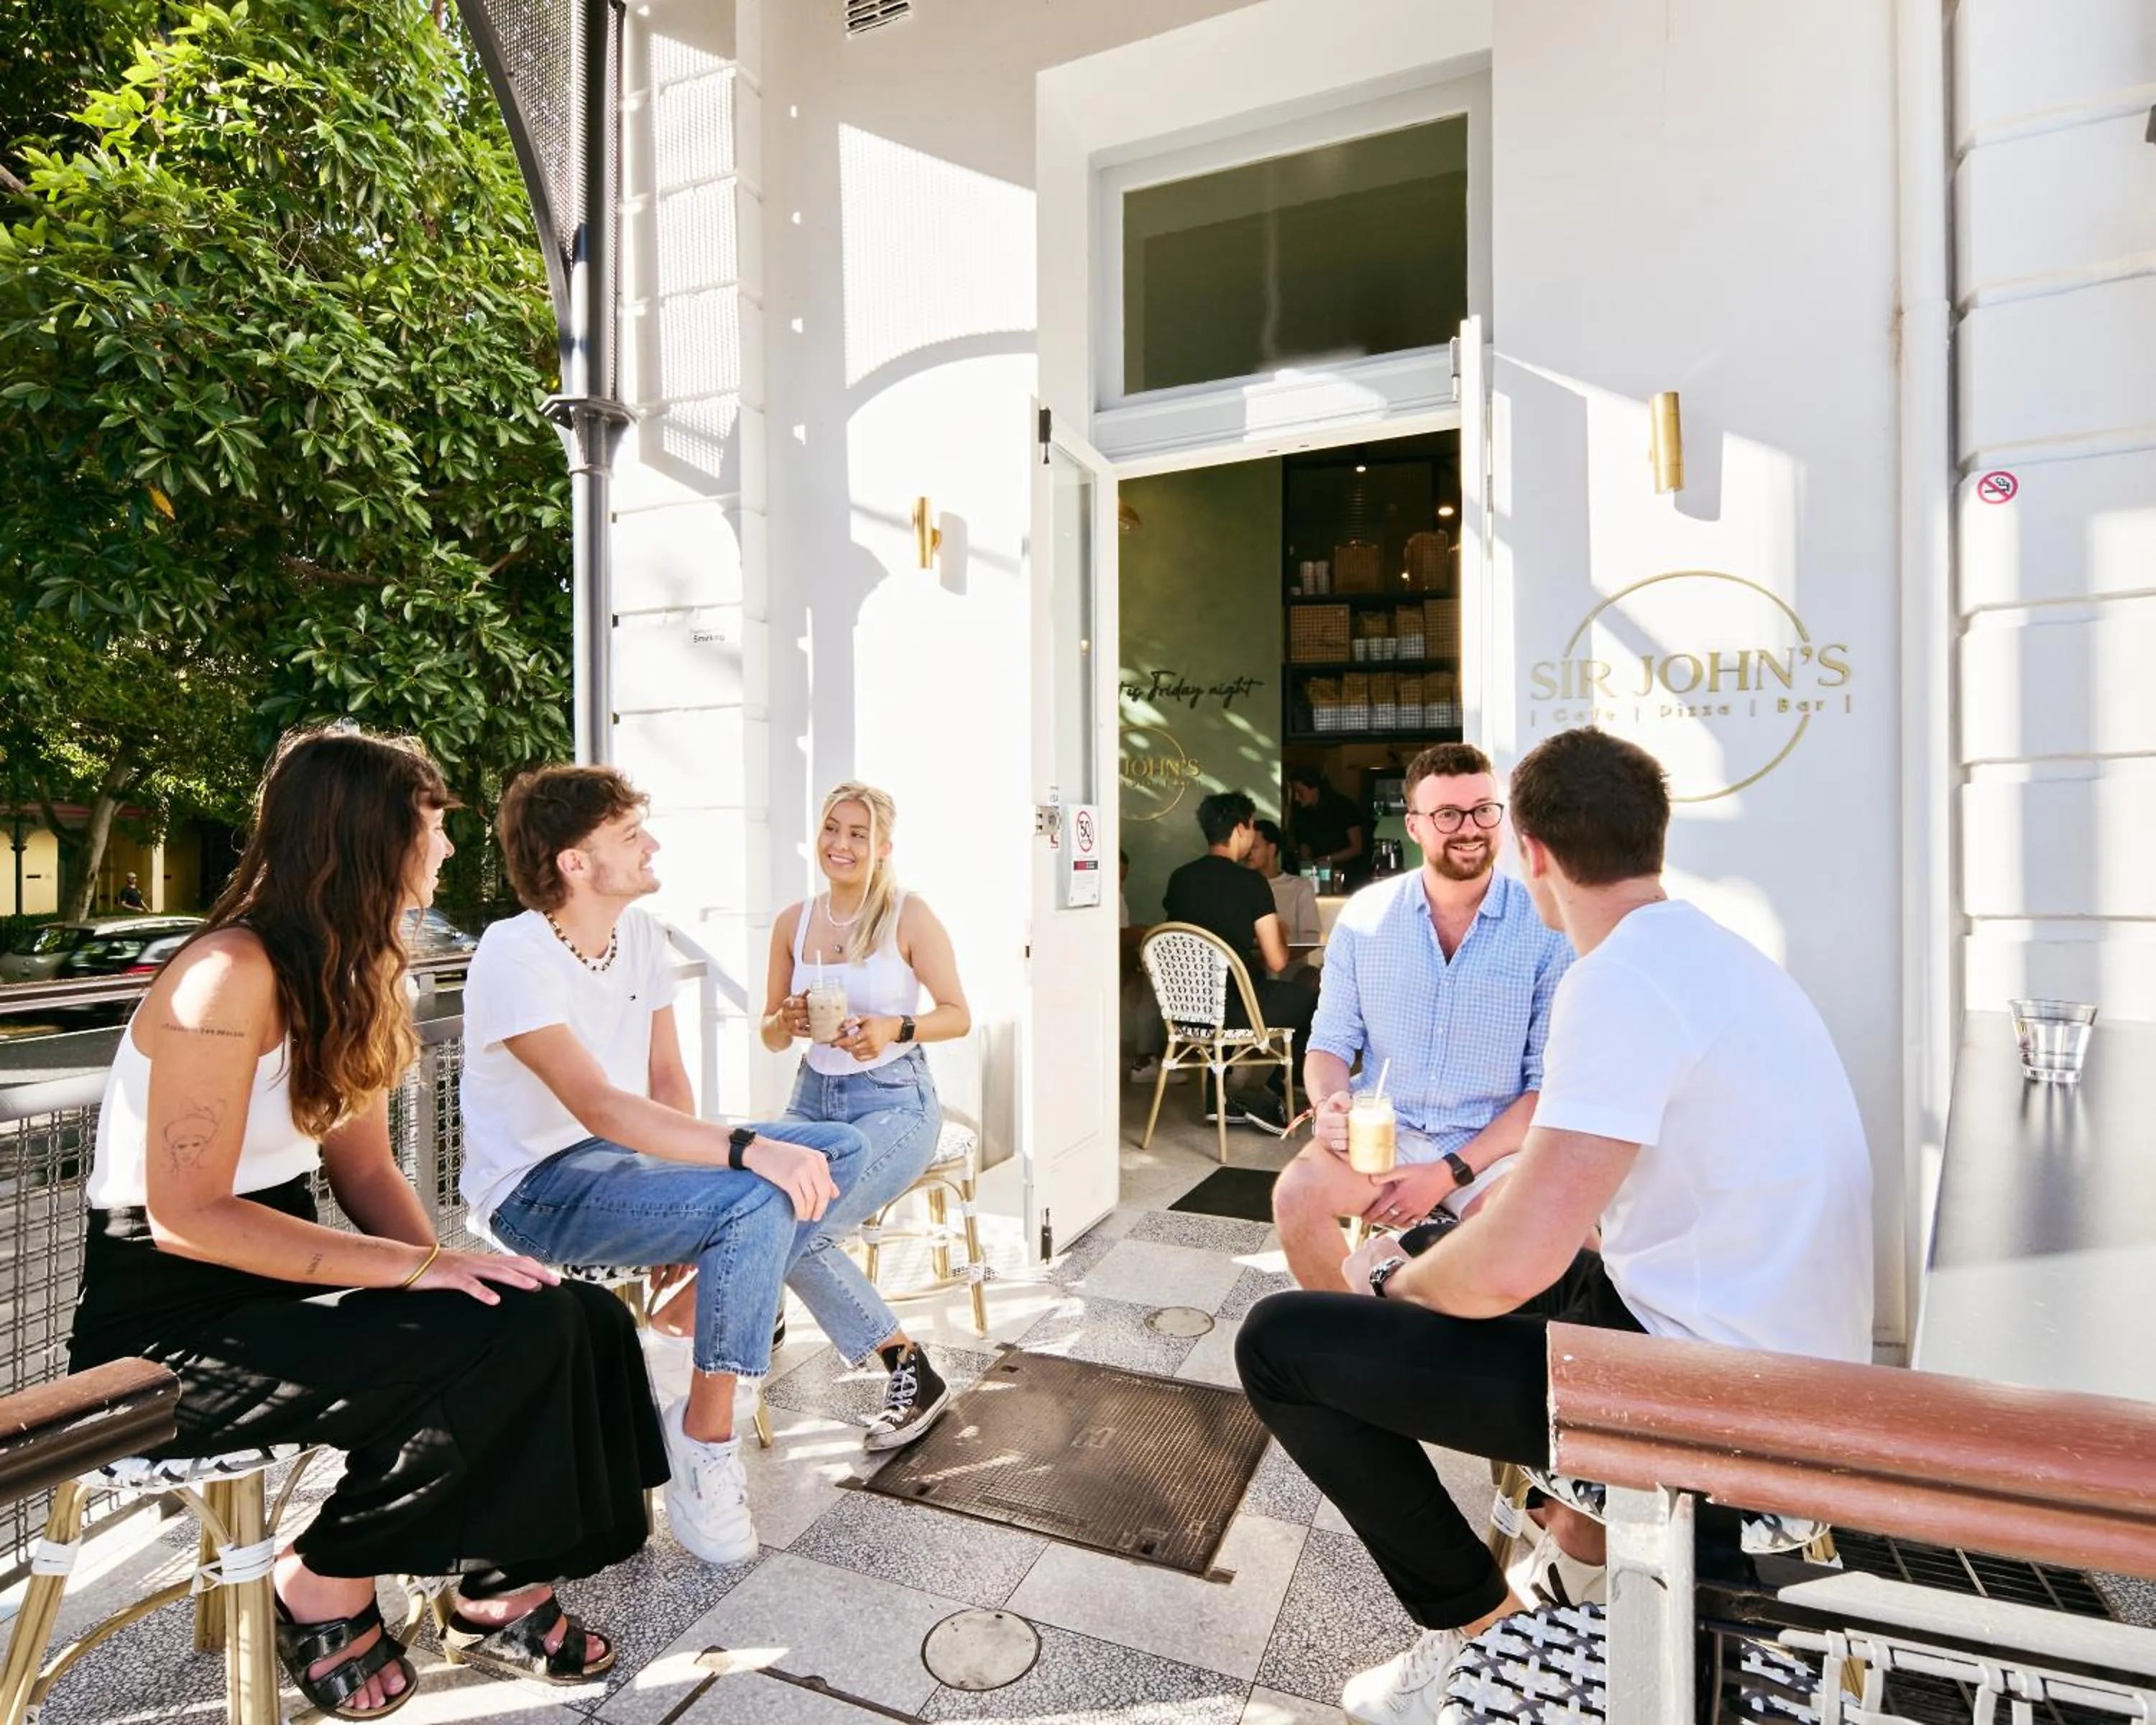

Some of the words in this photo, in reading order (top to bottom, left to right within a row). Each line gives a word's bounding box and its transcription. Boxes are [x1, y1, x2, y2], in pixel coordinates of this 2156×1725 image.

[1530, 658, 1617, 701] SIR
[1632, 644, 1852, 697] JOHN'S
[1148, 671, 1204, 709] Friday
[1209, 676, 1265, 709] night
[1660, 702, 1730, 717] Pizza
[1777, 697, 1825, 713] Bar
[1124, 758, 1199, 777] JOHN'S
